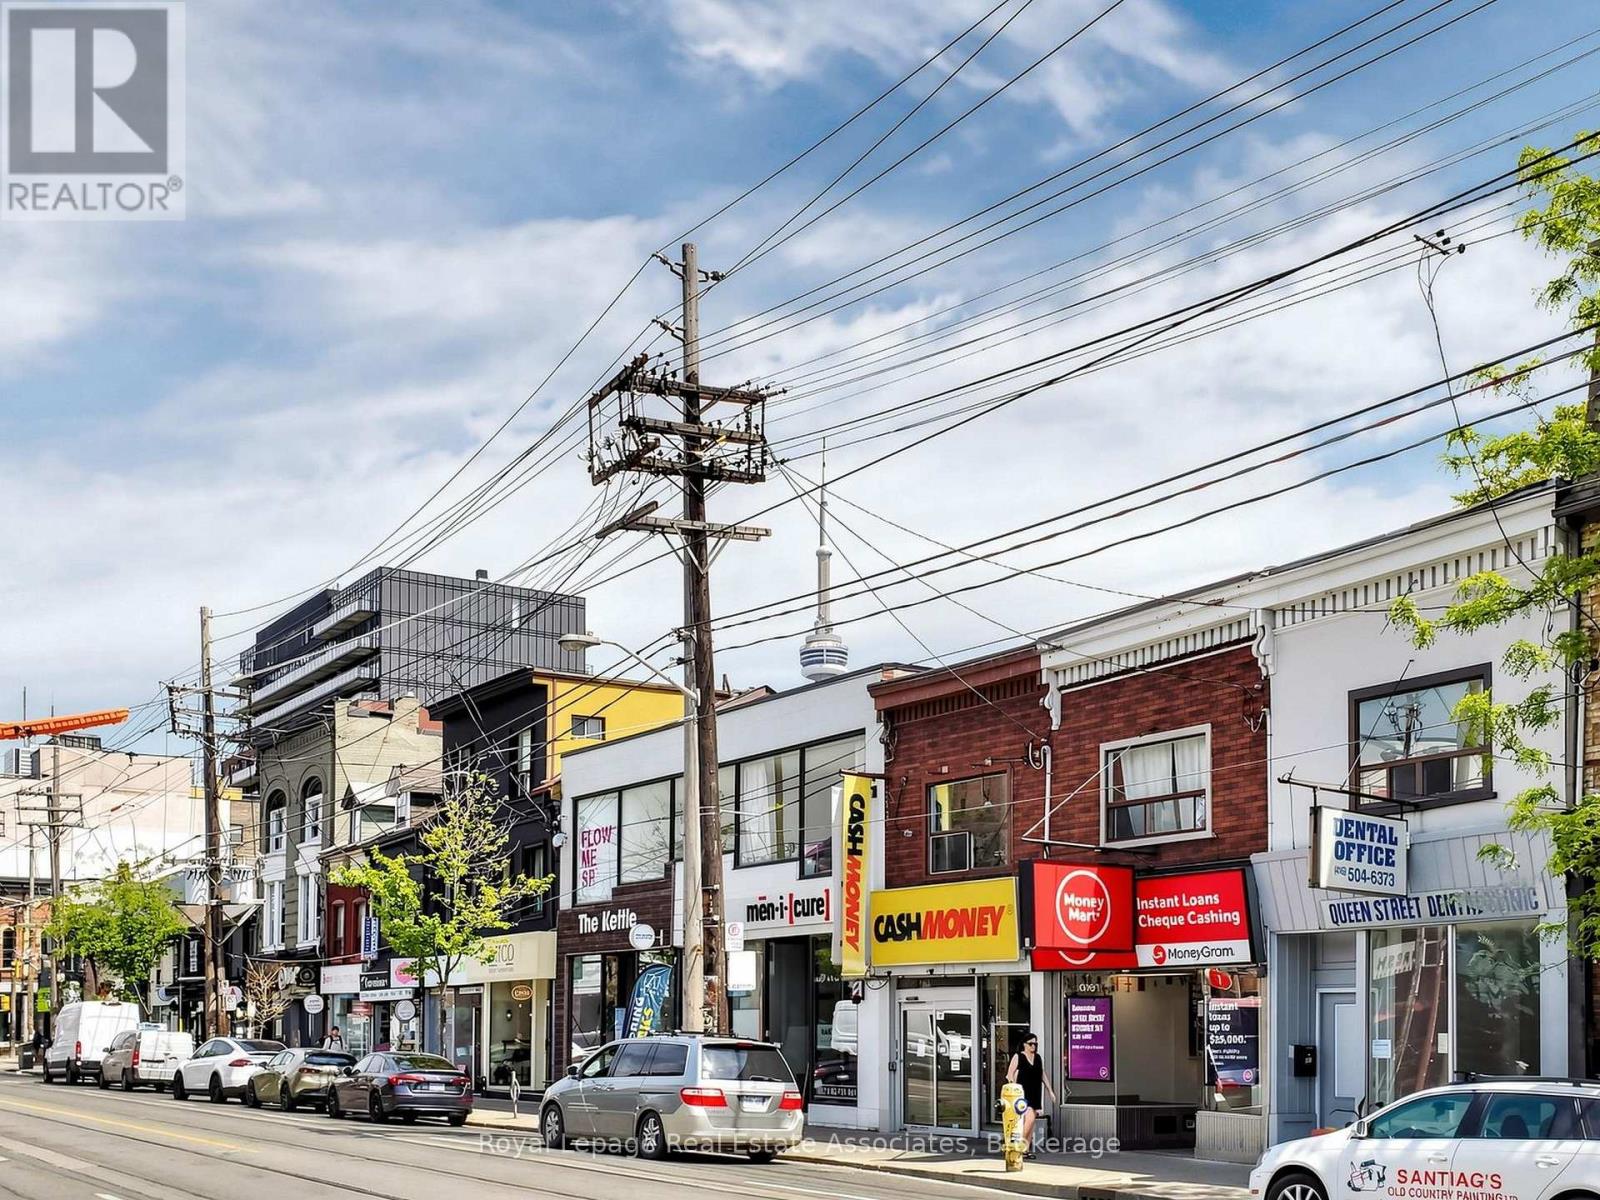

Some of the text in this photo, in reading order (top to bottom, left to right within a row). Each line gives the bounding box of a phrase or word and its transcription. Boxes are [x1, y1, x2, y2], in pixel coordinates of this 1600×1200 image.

[581, 825, 613, 848] FLOW
[1333, 817, 1398, 846] DENTAL
[581, 849, 597, 868] ME
[1334, 840, 1396, 868] OFFICE
[1347, 867, 1395, 887] 504-6373
[1063, 892, 1104, 911] Money
[1136, 893, 1220, 910] Instant Loans
[1329, 901, 1372, 926] QUEEN
[1373, 896, 1421, 921] STREET
[578, 908, 637, 934] The Kettle
[1138, 909, 1240, 929] Cheque Cashing
[1209, 1023, 1230, 1033] up to
[1397, 1169, 1502, 1190] SANTIAG'S
[1387, 1186, 1406, 1197] OLD
[1409, 1187, 1454, 1200] COUNTRY
